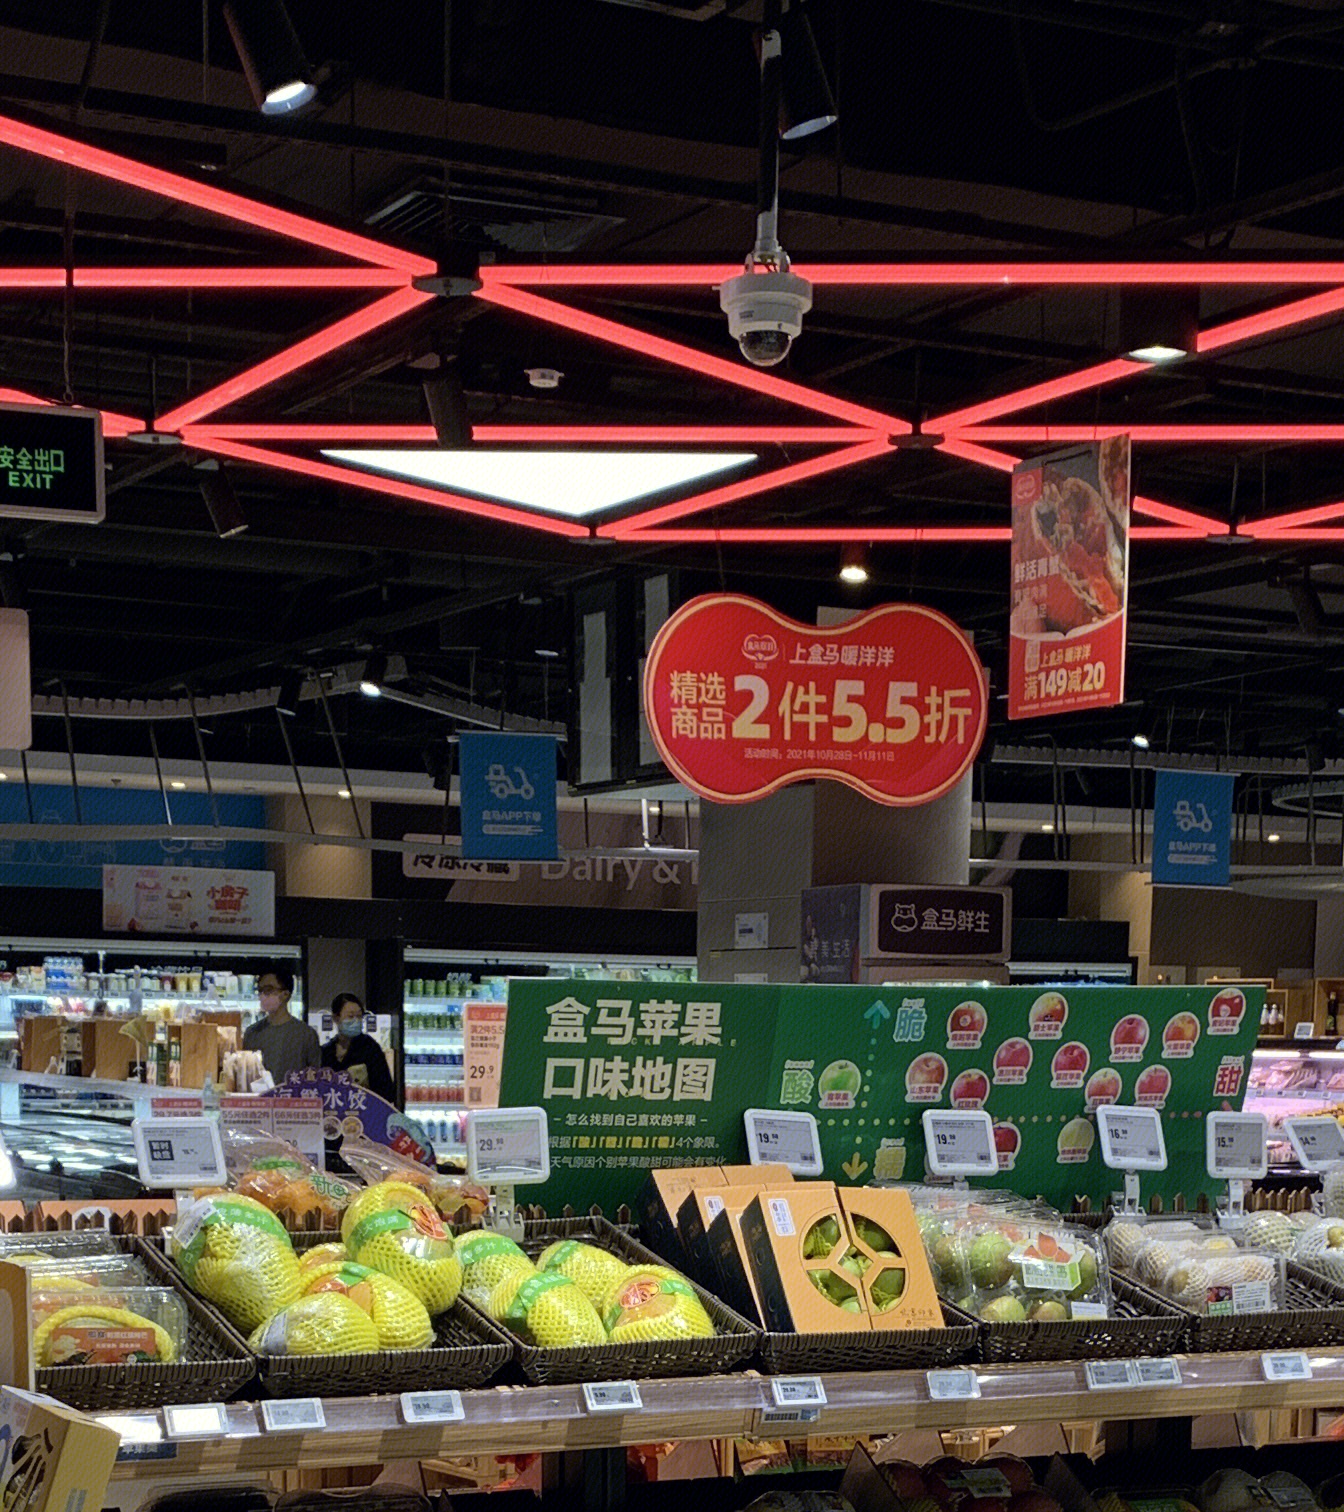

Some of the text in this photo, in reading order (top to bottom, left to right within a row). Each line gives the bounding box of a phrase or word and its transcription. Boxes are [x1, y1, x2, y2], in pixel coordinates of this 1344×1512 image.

[8, 472, 54, 489] EXIT
[789, 643, 895, 667] 上盒马暖洋洋
[670, 670, 726, 705] 精选
[1024, 662, 1105, 700] 满149减20
[670, 706, 726, 740] 商品
[731, 674, 973, 744] 2件5.5折
[921, 907, 990, 933] 盒马鲜生
[543, 996, 723, 1046] 盒马苹果
[896, 1008, 926, 1040] 脆
[469, 1065, 494, 1079] 29.9
[543, 1056, 717, 1102] 口味地图
[782, 1072, 813, 1103] 酸
[1213, 1063, 1243, 1096] 甜
[565, 1113, 697, 1128] 怎么找到自己喜欢的苹果
